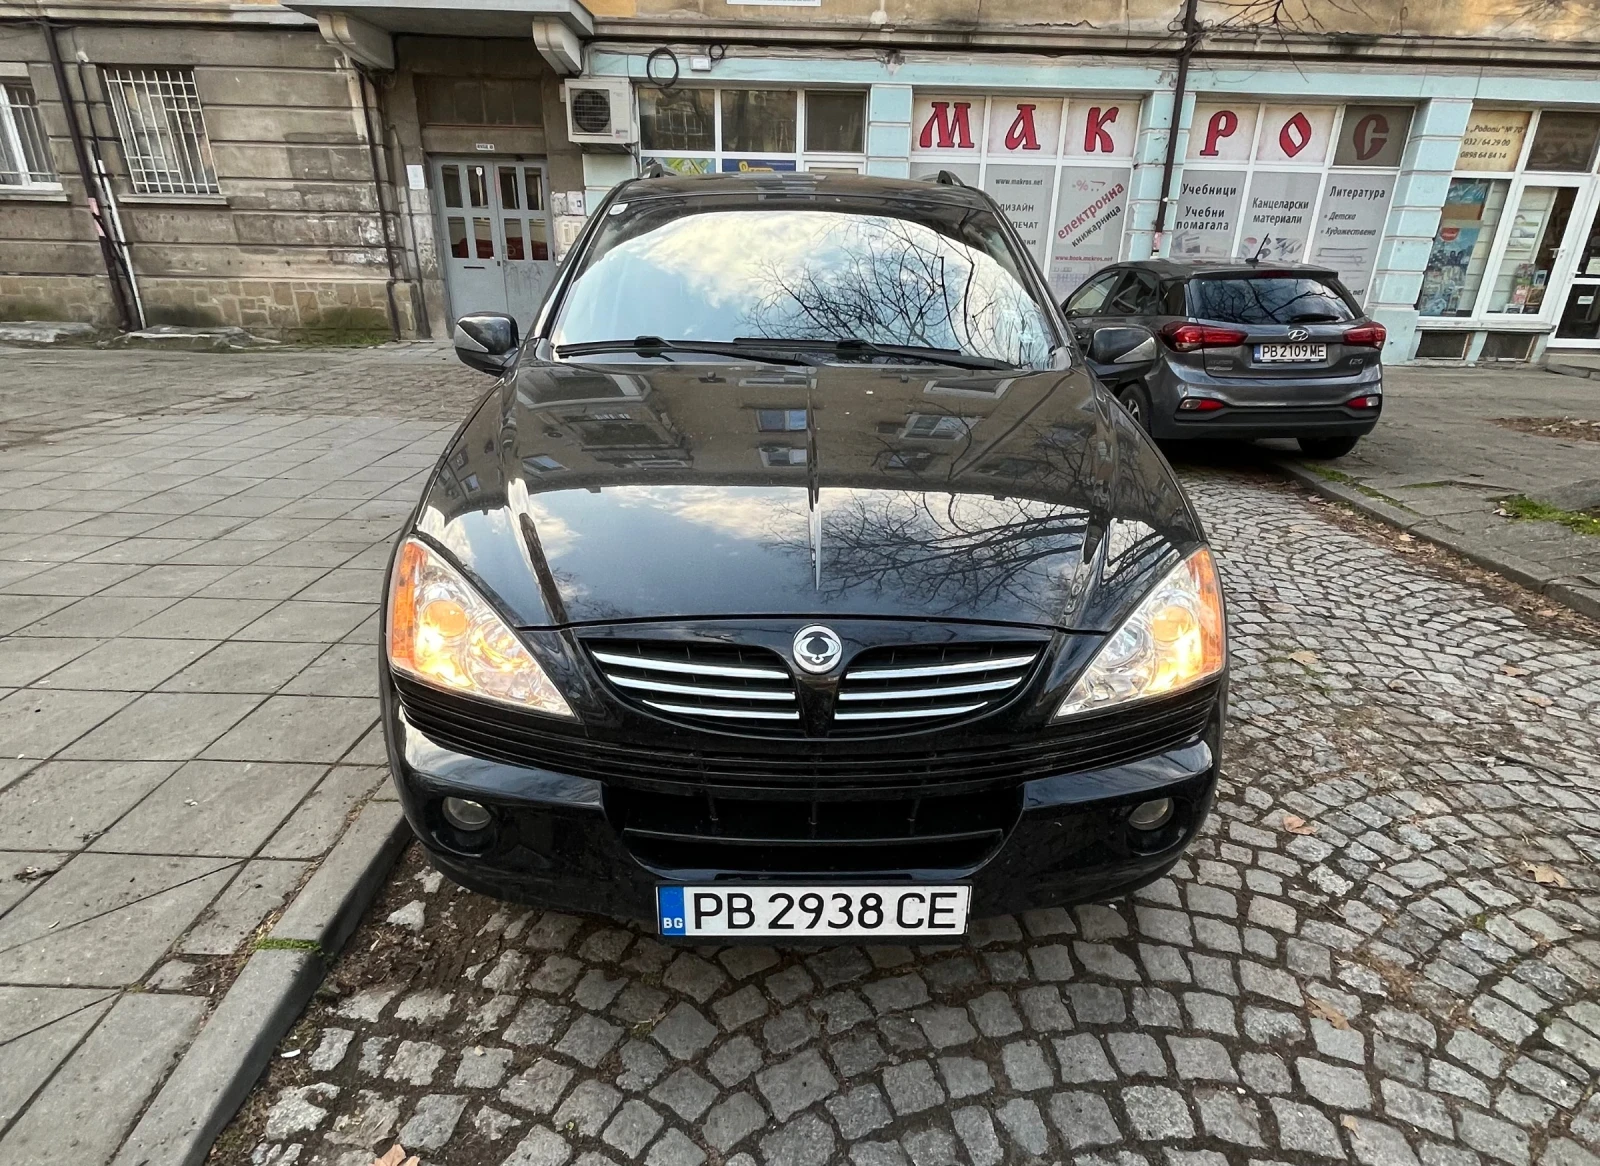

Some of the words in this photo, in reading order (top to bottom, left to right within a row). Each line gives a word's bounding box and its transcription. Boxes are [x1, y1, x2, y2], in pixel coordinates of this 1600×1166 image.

[995, 178, 1043, 186] www.makros.net
[1181, 183, 1237, 198] Учебници
[1329, 185, 1386, 201] Литература
[1057, 182, 1125, 240] електронна
[1184, 205, 1225, 218] Учебни
[1251, 197, 1310, 212] Канцеларски
[1071, 205, 1121, 248] книжарница
[1176, 220, 1229, 231] помагала
[1252, 214, 1303, 226] материали
[1262, 345, 1278, 358] PB
[1280, 344, 1308, 358] 2109
[1310, 344, 1325, 357] ME
[693, 892, 755, 930] PB
[768, 892, 884, 930] 2938
[896, 892, 958, 930] CE
[663, 917, 683, 928] BG
